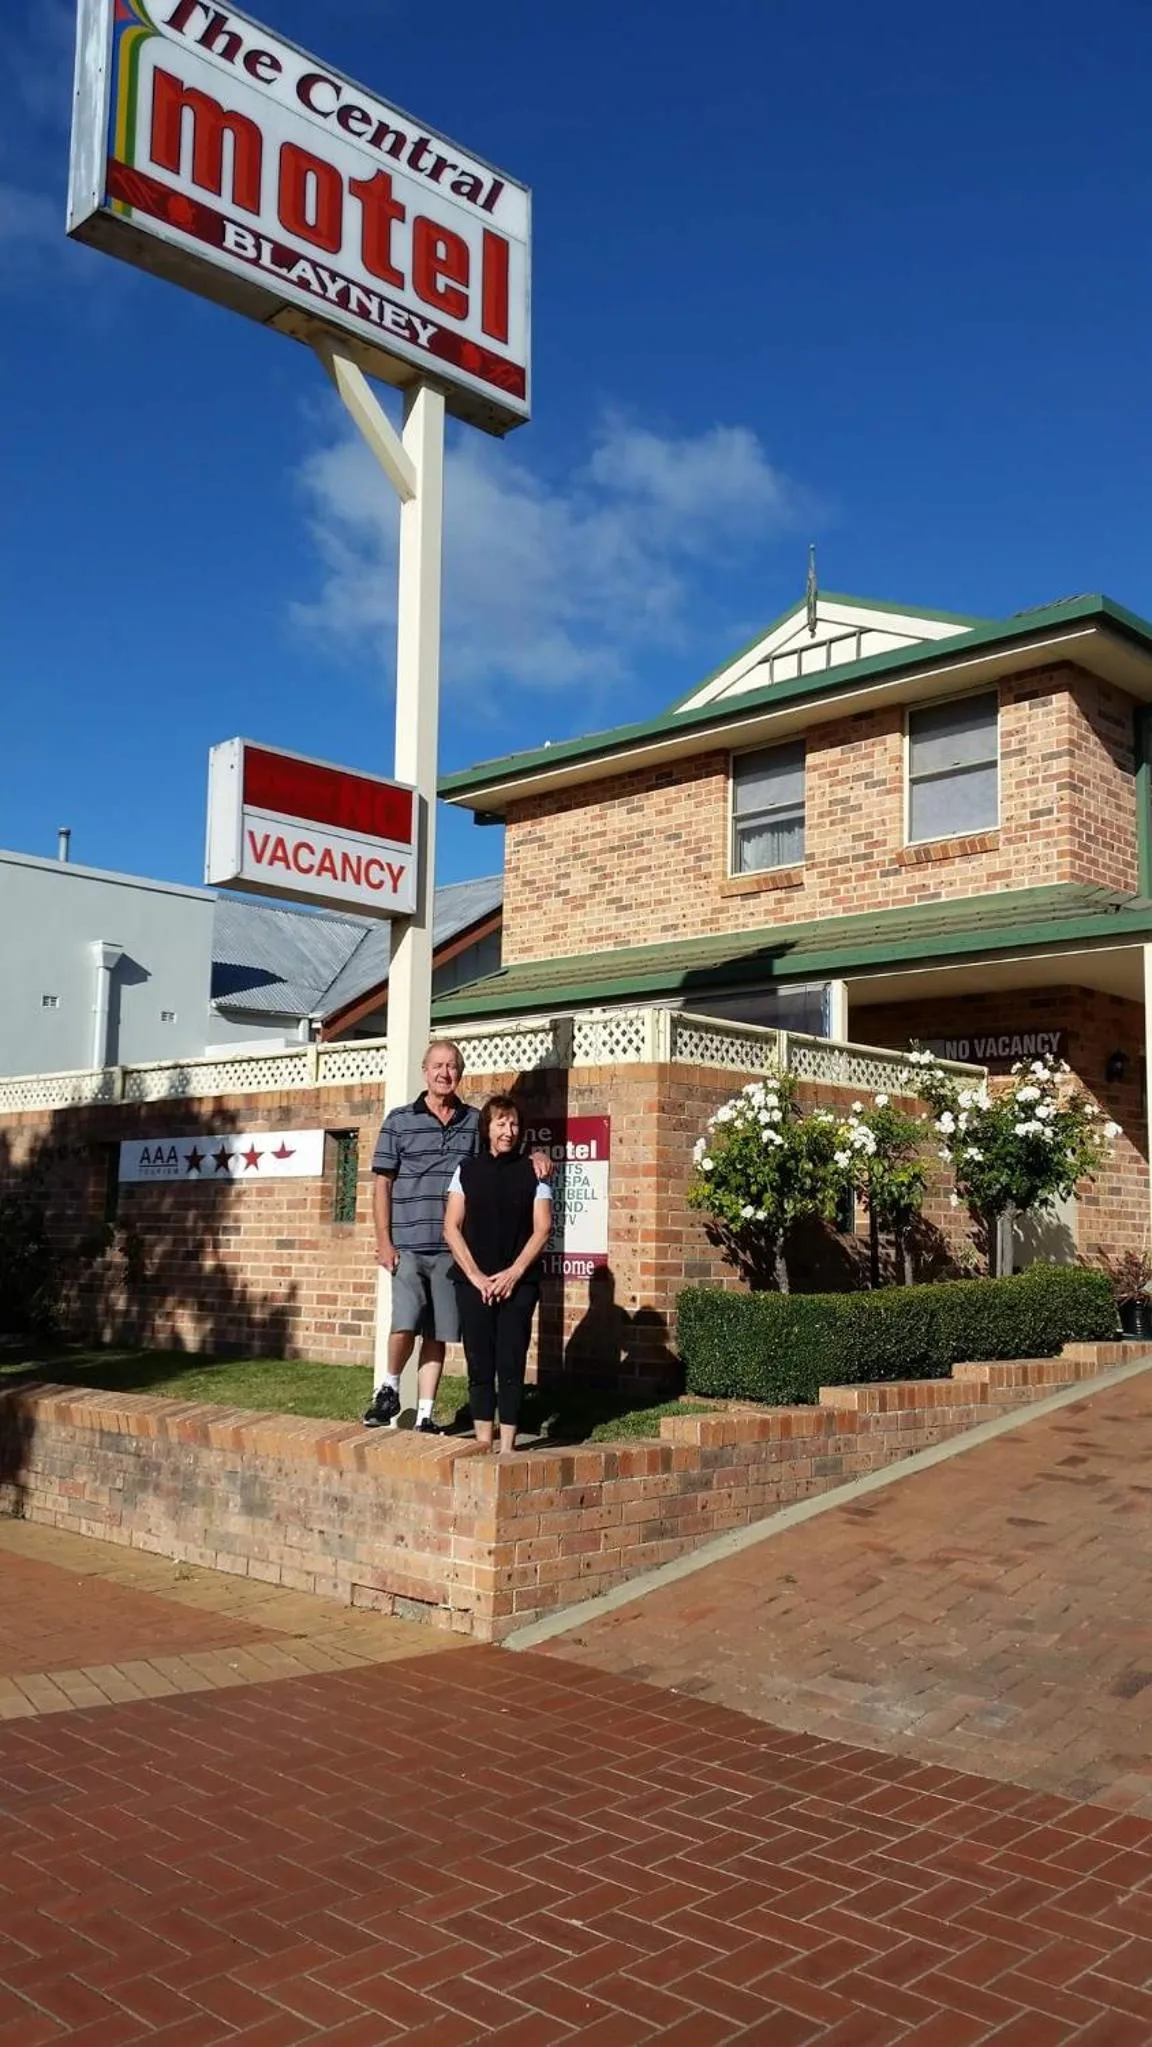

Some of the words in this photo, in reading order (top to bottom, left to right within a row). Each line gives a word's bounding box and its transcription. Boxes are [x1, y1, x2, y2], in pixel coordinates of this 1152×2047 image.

[162, 0, 283, 85] The
[296, 72, 504, 214] Central
[149, 65, 510, 345] motel
[222, 220, 438, 350] BLAYNEY
[247, 829, 406, 894] VACANCY
[945, 1039, 969, 1060] NO
[973, 1031, 1061, 1058] VACANCY
[139, 1145, 178, 1164] AAA
[563, 1175, 591, 1188] SPA
[567, 1188, 598, 1200] BELL
[551, 1254, 595, 1276] Home
